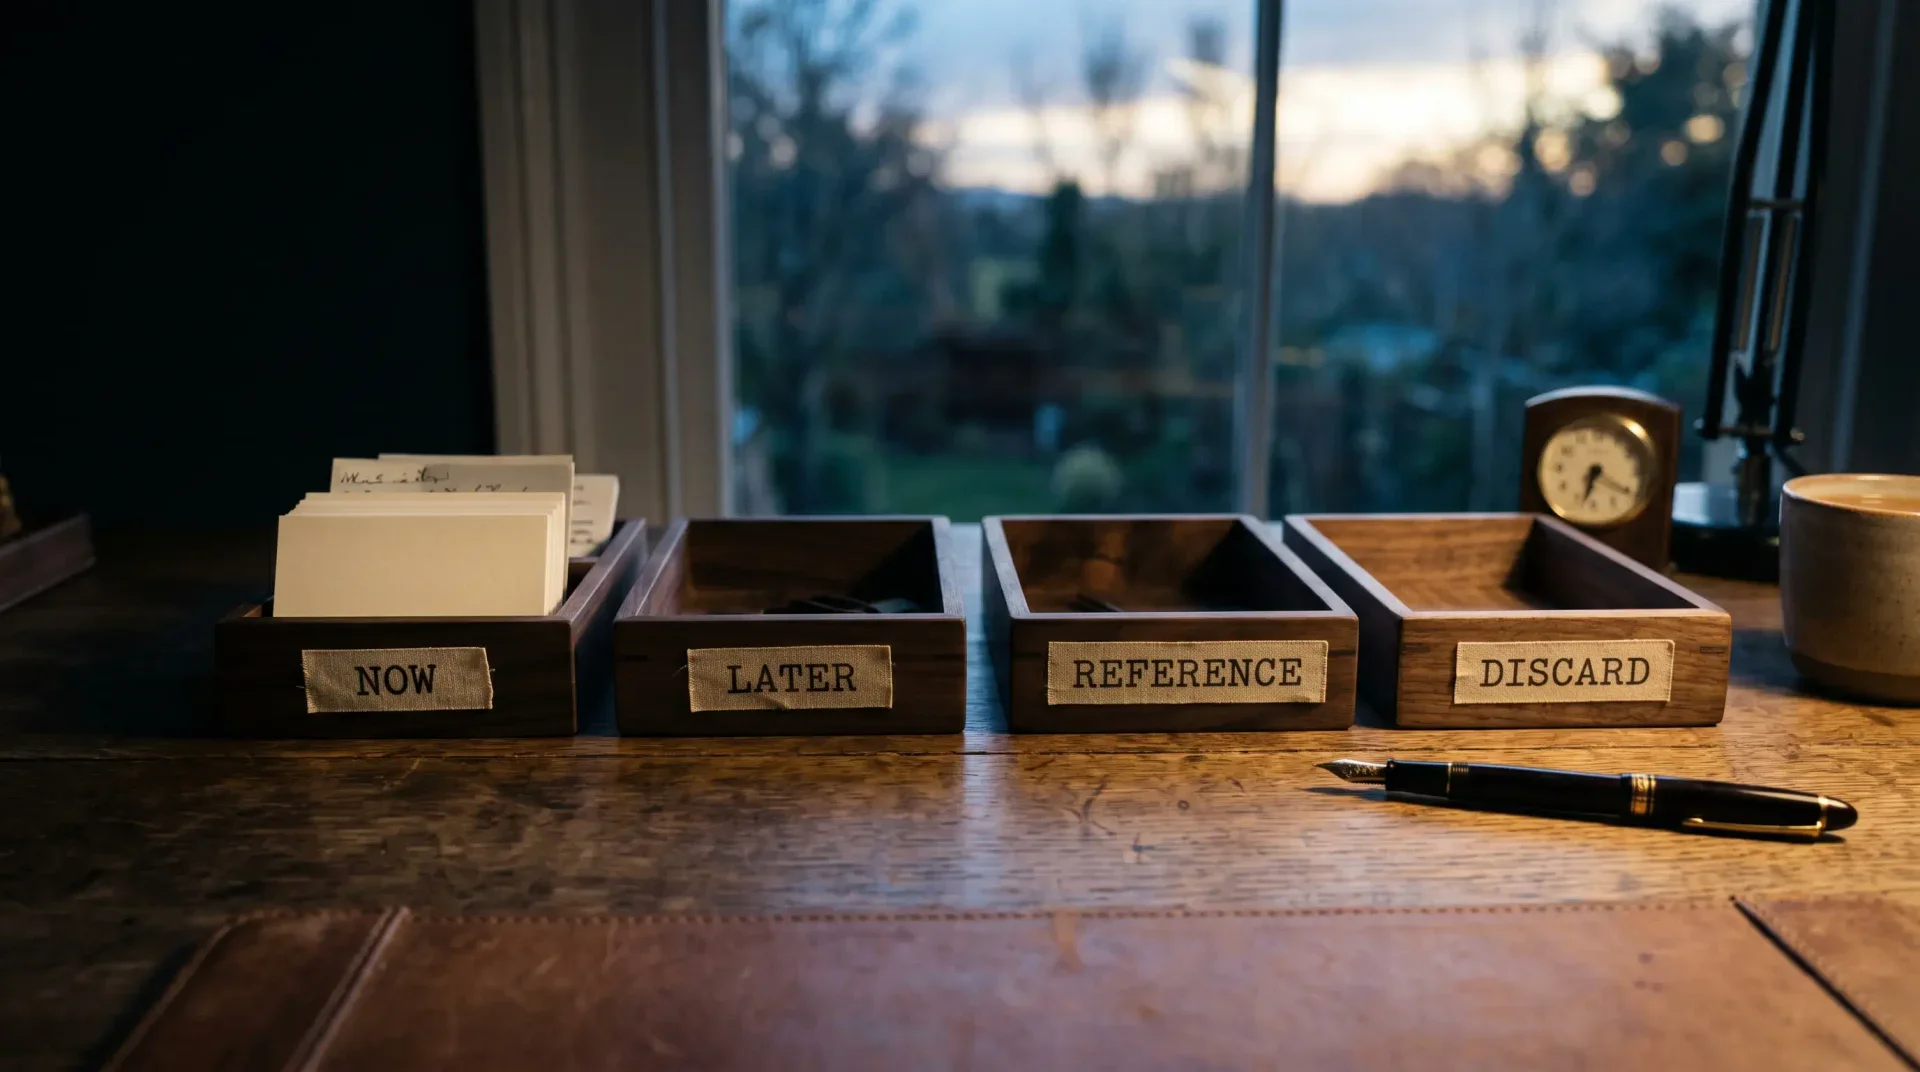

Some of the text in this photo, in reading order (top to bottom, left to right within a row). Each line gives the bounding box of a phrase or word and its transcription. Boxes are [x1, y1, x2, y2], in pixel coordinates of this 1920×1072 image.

[356, 664, 436, 695] NOW
[727, 662, 857, 694] LATER
[1073, 658, 1302, 689] REFERENCE
[1480, 657, 1650, 687] DISCARD
